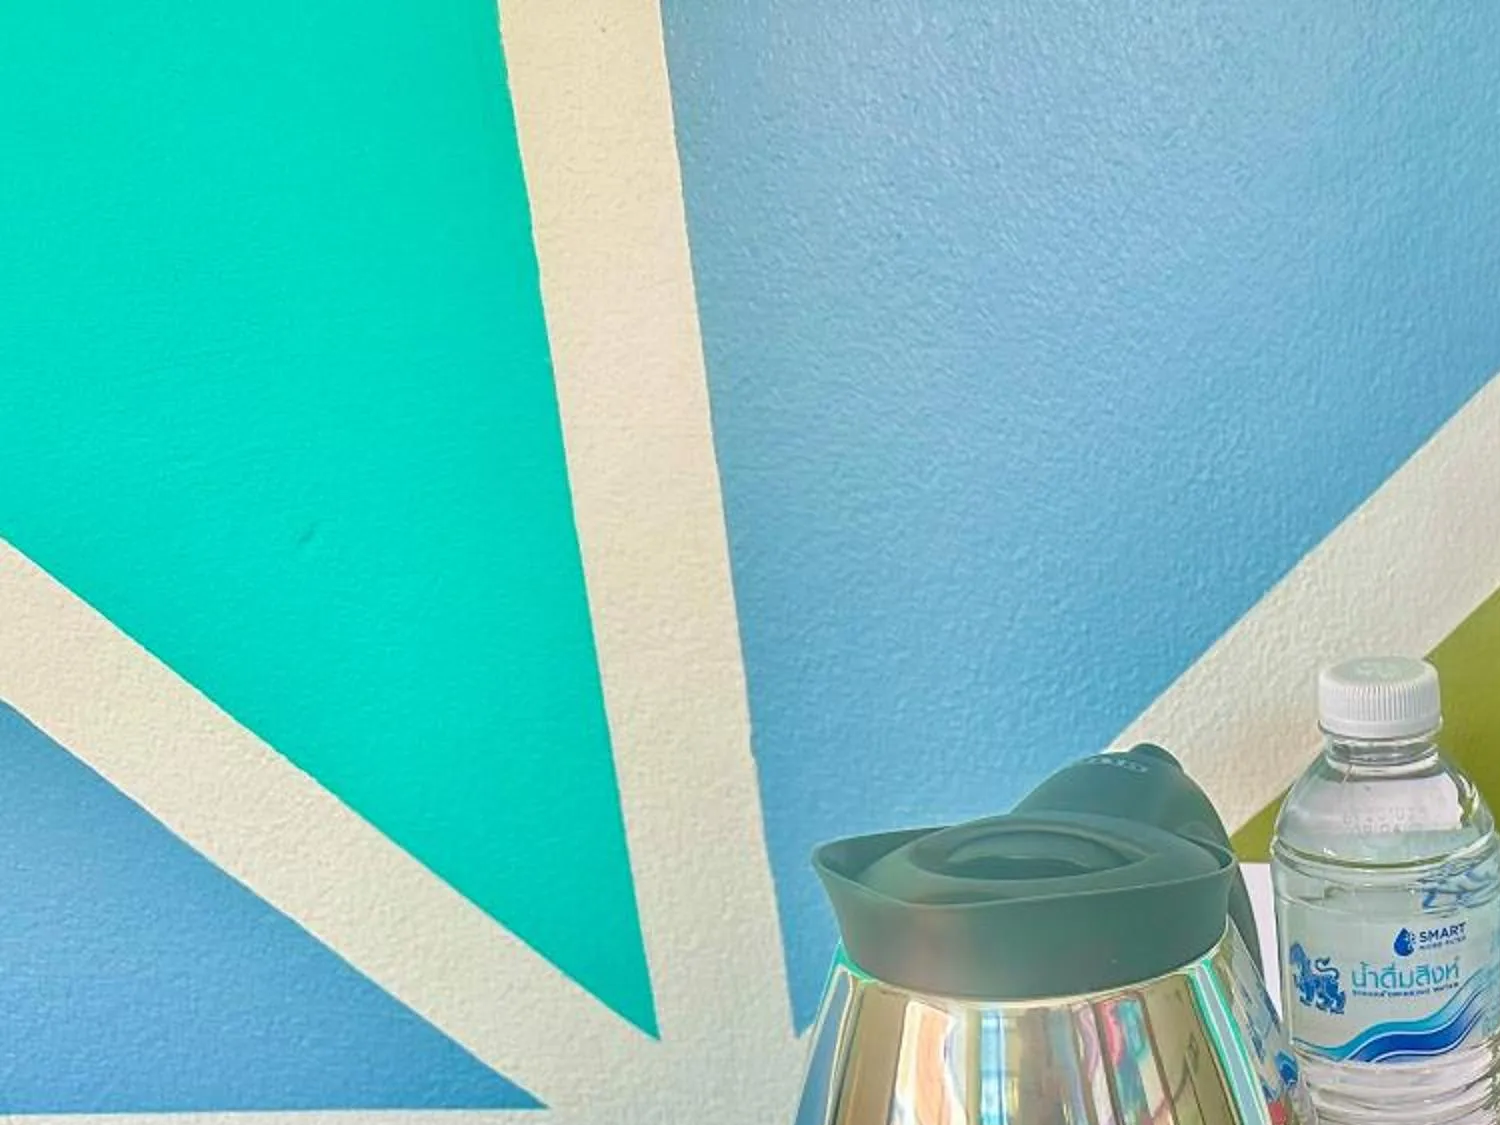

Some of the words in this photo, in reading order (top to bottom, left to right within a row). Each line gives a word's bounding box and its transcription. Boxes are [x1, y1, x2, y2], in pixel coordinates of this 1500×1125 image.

[1419, 922, 1467, 943] SMART
[1351, 955, 1460, 989] น้ำดื่มสิงห์
